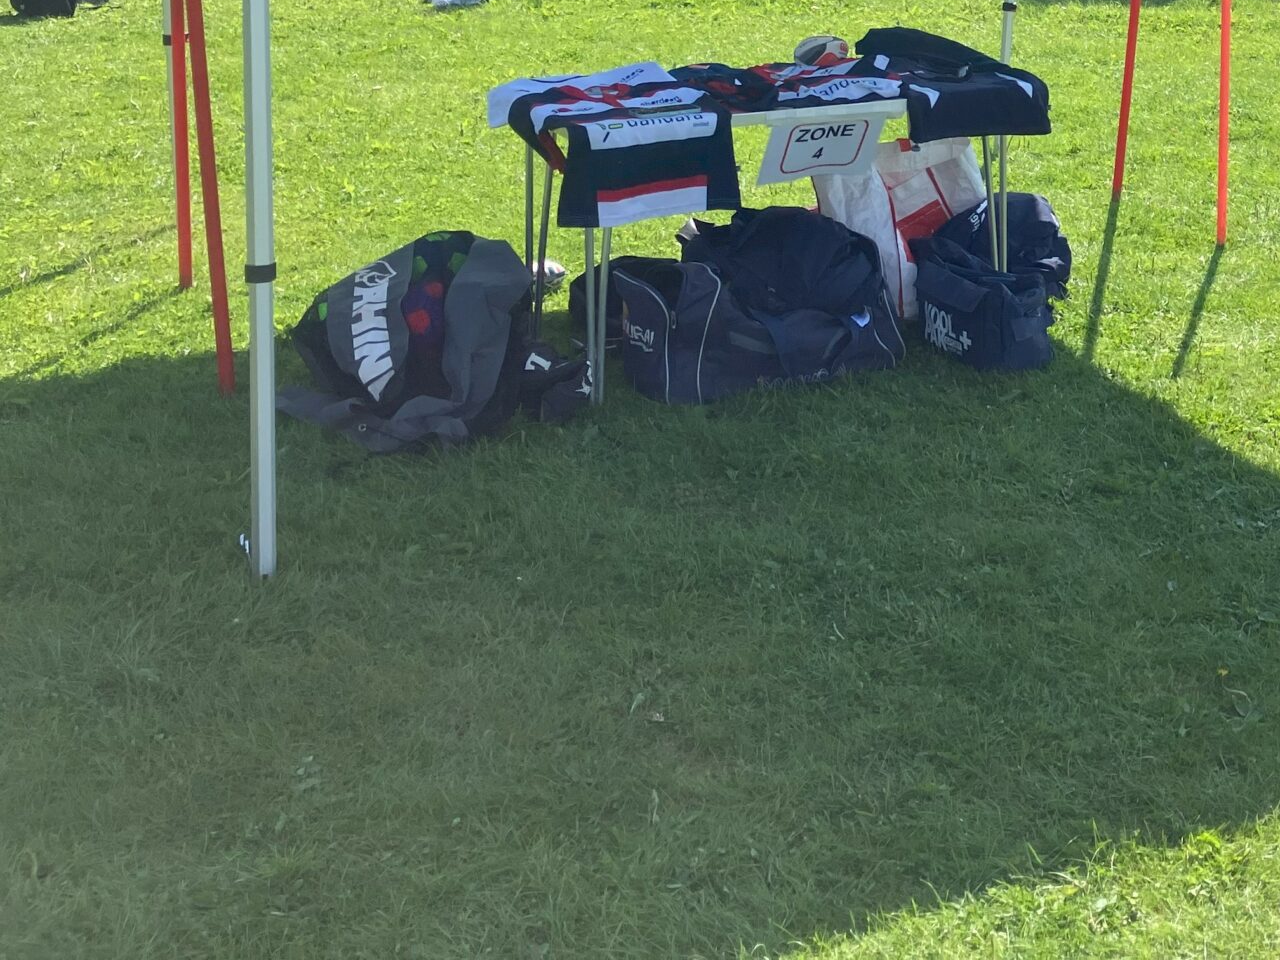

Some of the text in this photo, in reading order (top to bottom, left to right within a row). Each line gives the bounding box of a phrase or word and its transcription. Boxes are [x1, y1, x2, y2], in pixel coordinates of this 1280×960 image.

[795, 124, 856, 142] ZONE
[811, 147, 824, 159] 4
[924, 300, 956, 339] KOOL
